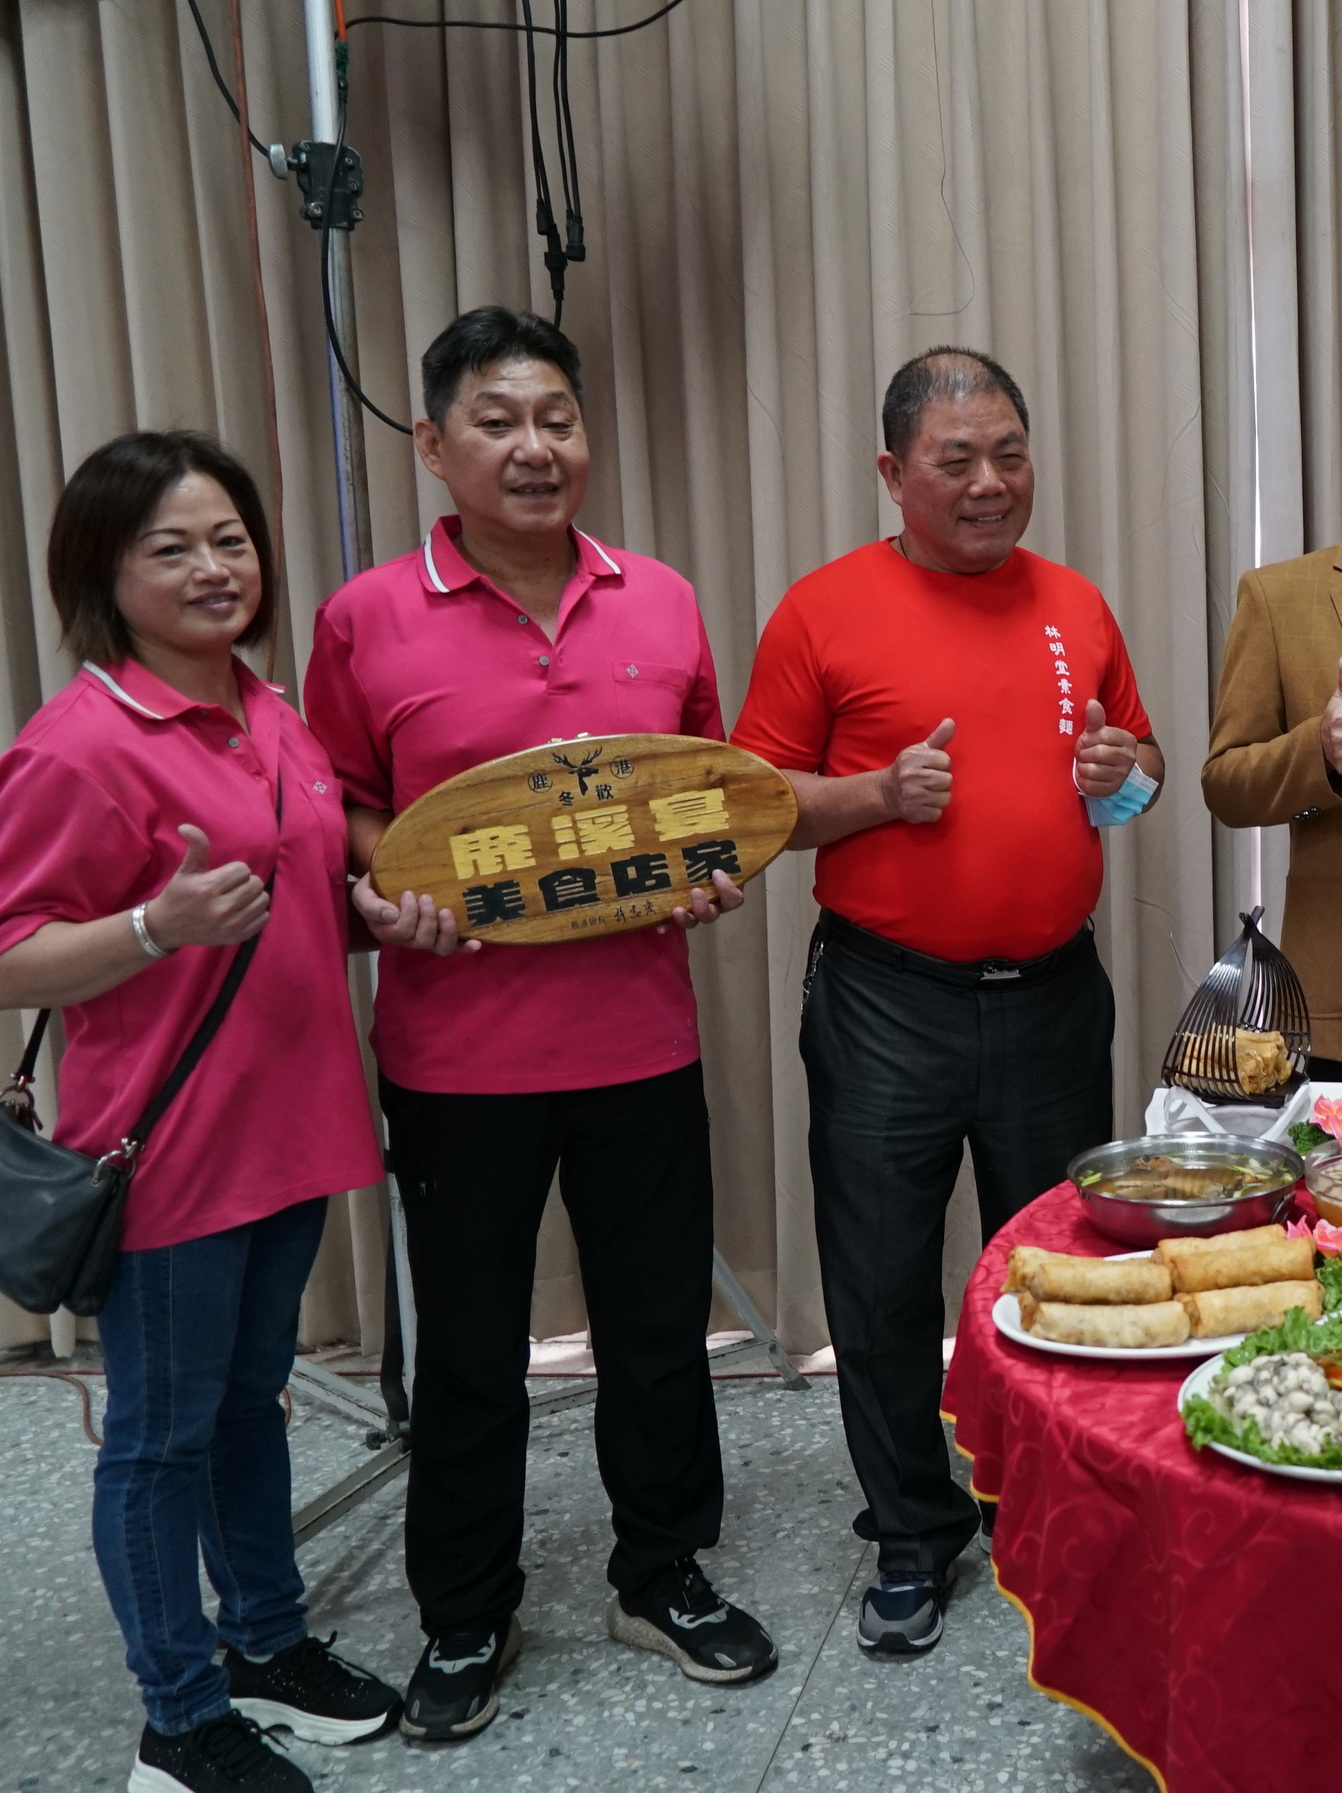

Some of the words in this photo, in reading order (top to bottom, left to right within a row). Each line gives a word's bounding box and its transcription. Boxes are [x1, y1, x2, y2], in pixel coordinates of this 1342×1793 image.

[1043, 624, 1075, 736] 林明堂素食麵
[461, 839, 743, 929] 美食店家
